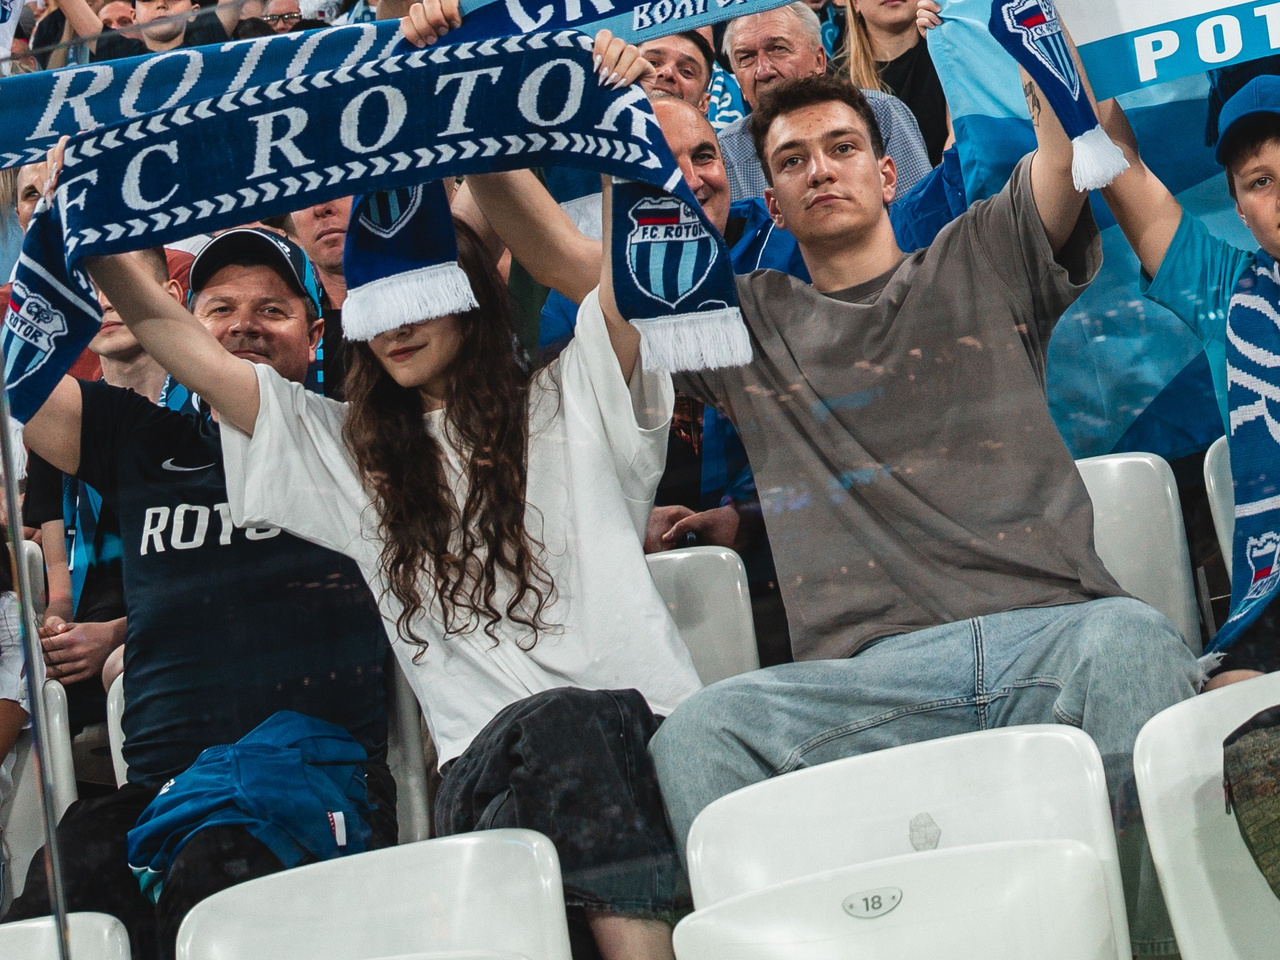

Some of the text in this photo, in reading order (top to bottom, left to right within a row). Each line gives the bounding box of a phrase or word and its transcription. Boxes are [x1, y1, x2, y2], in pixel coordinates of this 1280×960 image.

[26, 22, 403, 142] ROTO
[140, 502, 281, 556] ROT
[862, 894, 883, 912] 18
